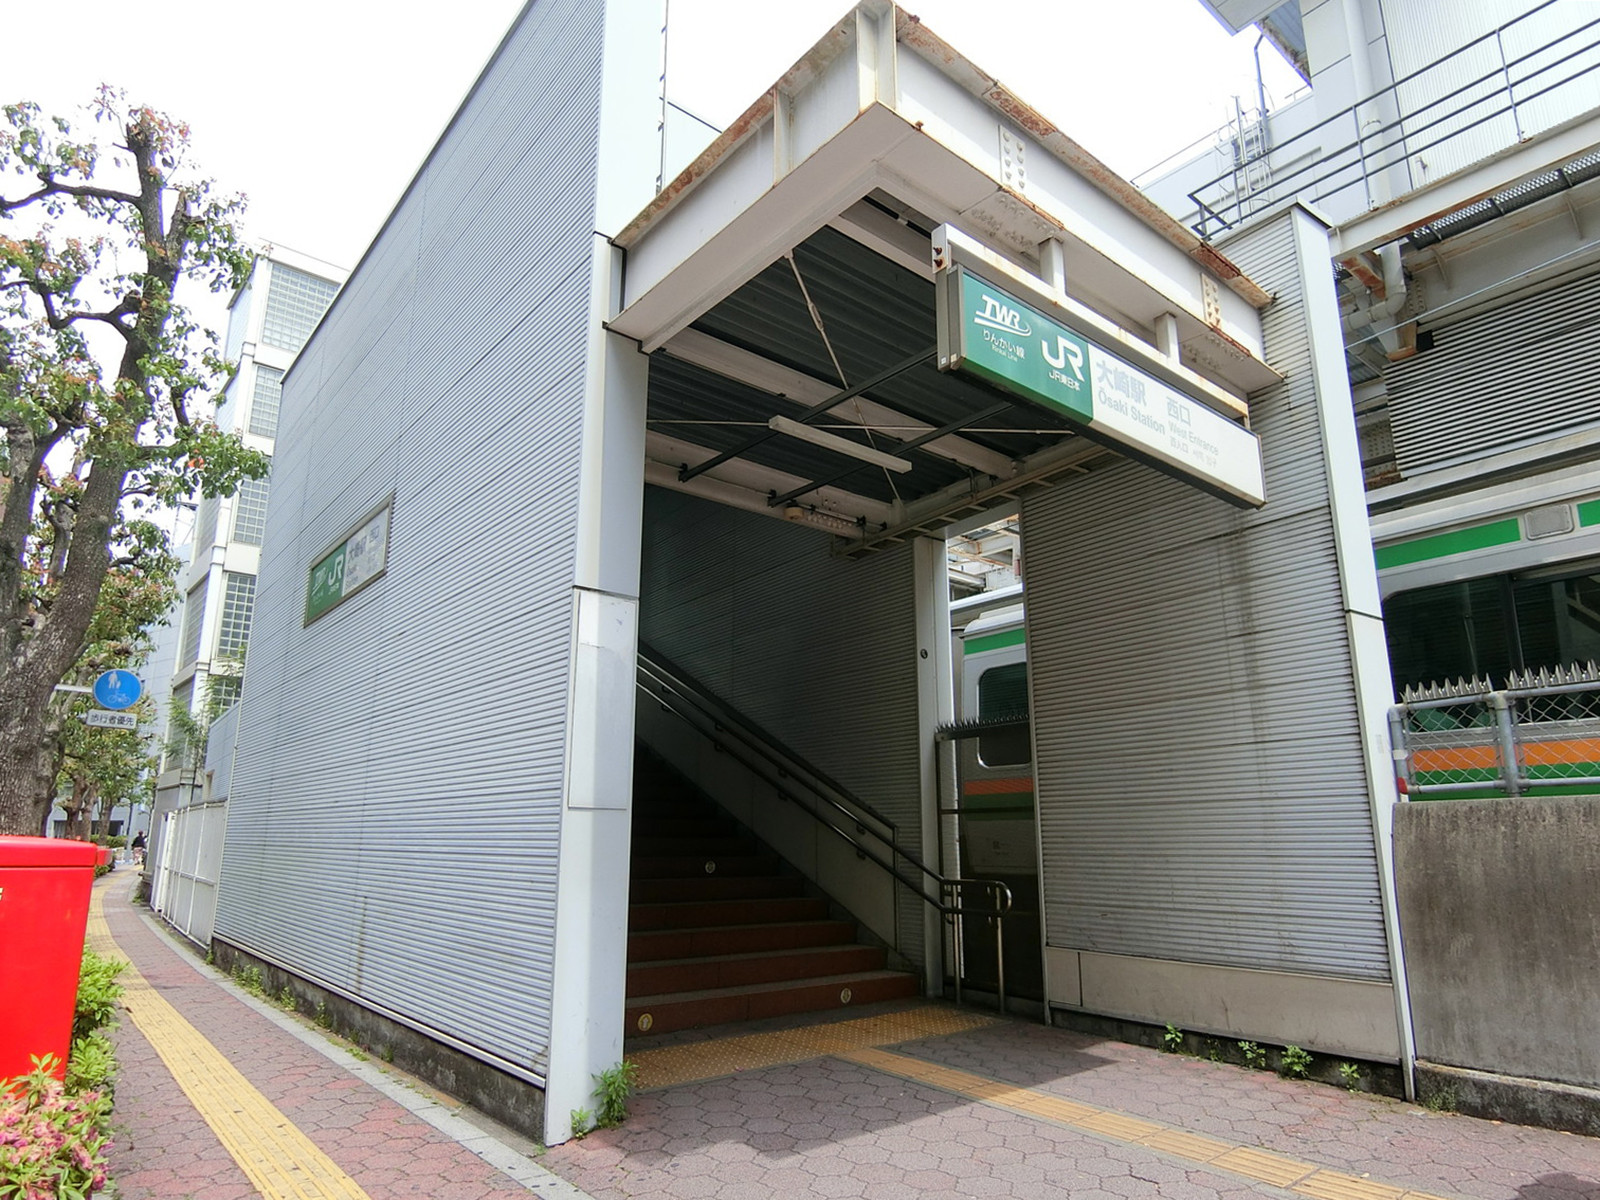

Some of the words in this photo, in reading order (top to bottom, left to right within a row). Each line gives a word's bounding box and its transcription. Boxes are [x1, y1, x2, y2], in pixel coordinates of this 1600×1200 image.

[1041, 334, 1085, 382] JR
[1130, 406, 1166, 435] Station
[1166, 396, 1191, 427] 西口
[327, 553, 344, 586] JR
[90, 713, 135, 727] 歩行者優先
